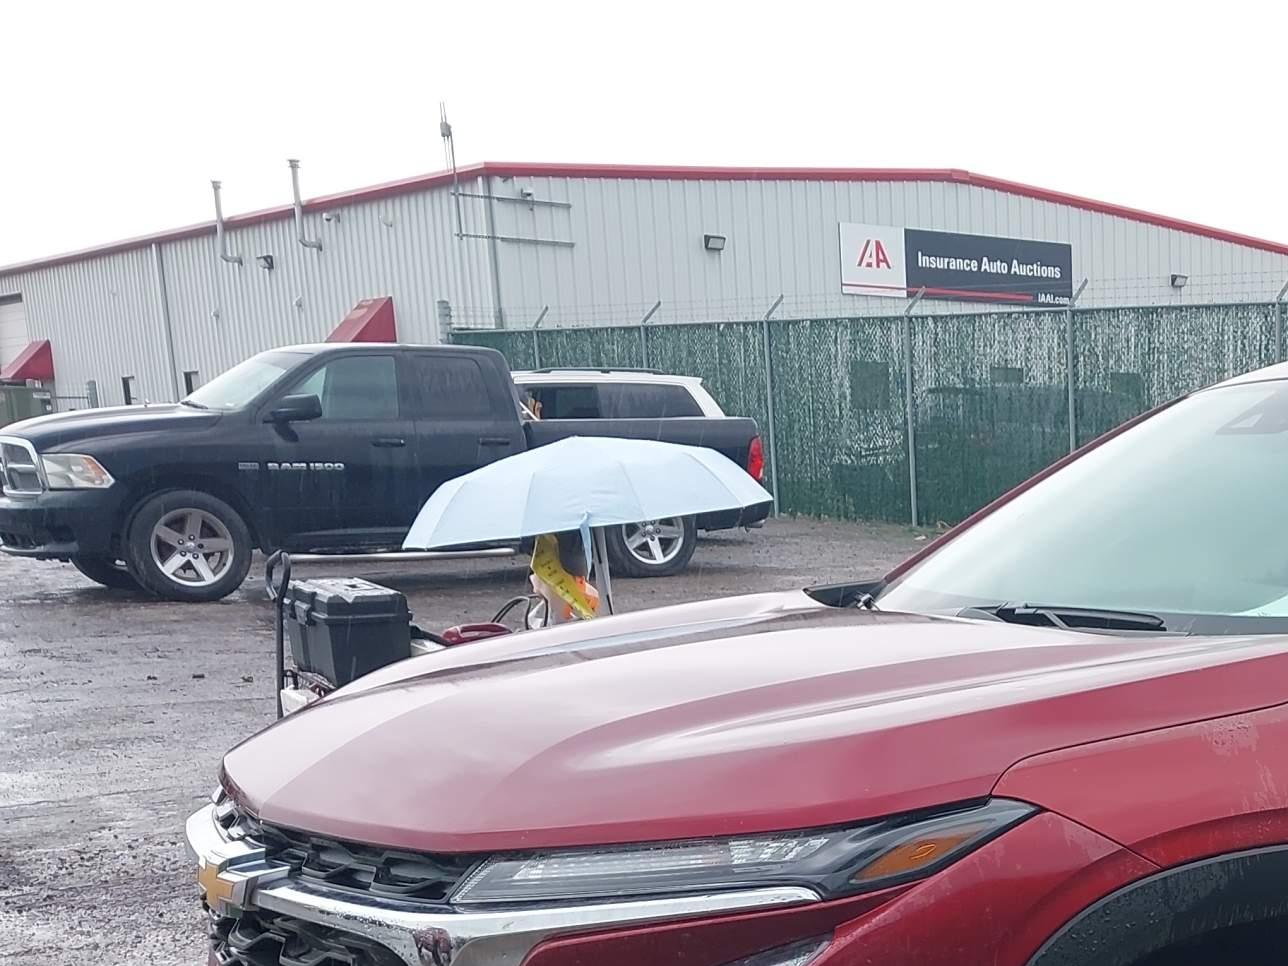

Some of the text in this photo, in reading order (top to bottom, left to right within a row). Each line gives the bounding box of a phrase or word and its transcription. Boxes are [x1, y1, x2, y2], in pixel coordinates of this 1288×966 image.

[917, 251, 1061, 279] Insurance Auto Auctions
[267, 462, 307, 471] RAM
[309, 462, 345, 471] 1500
